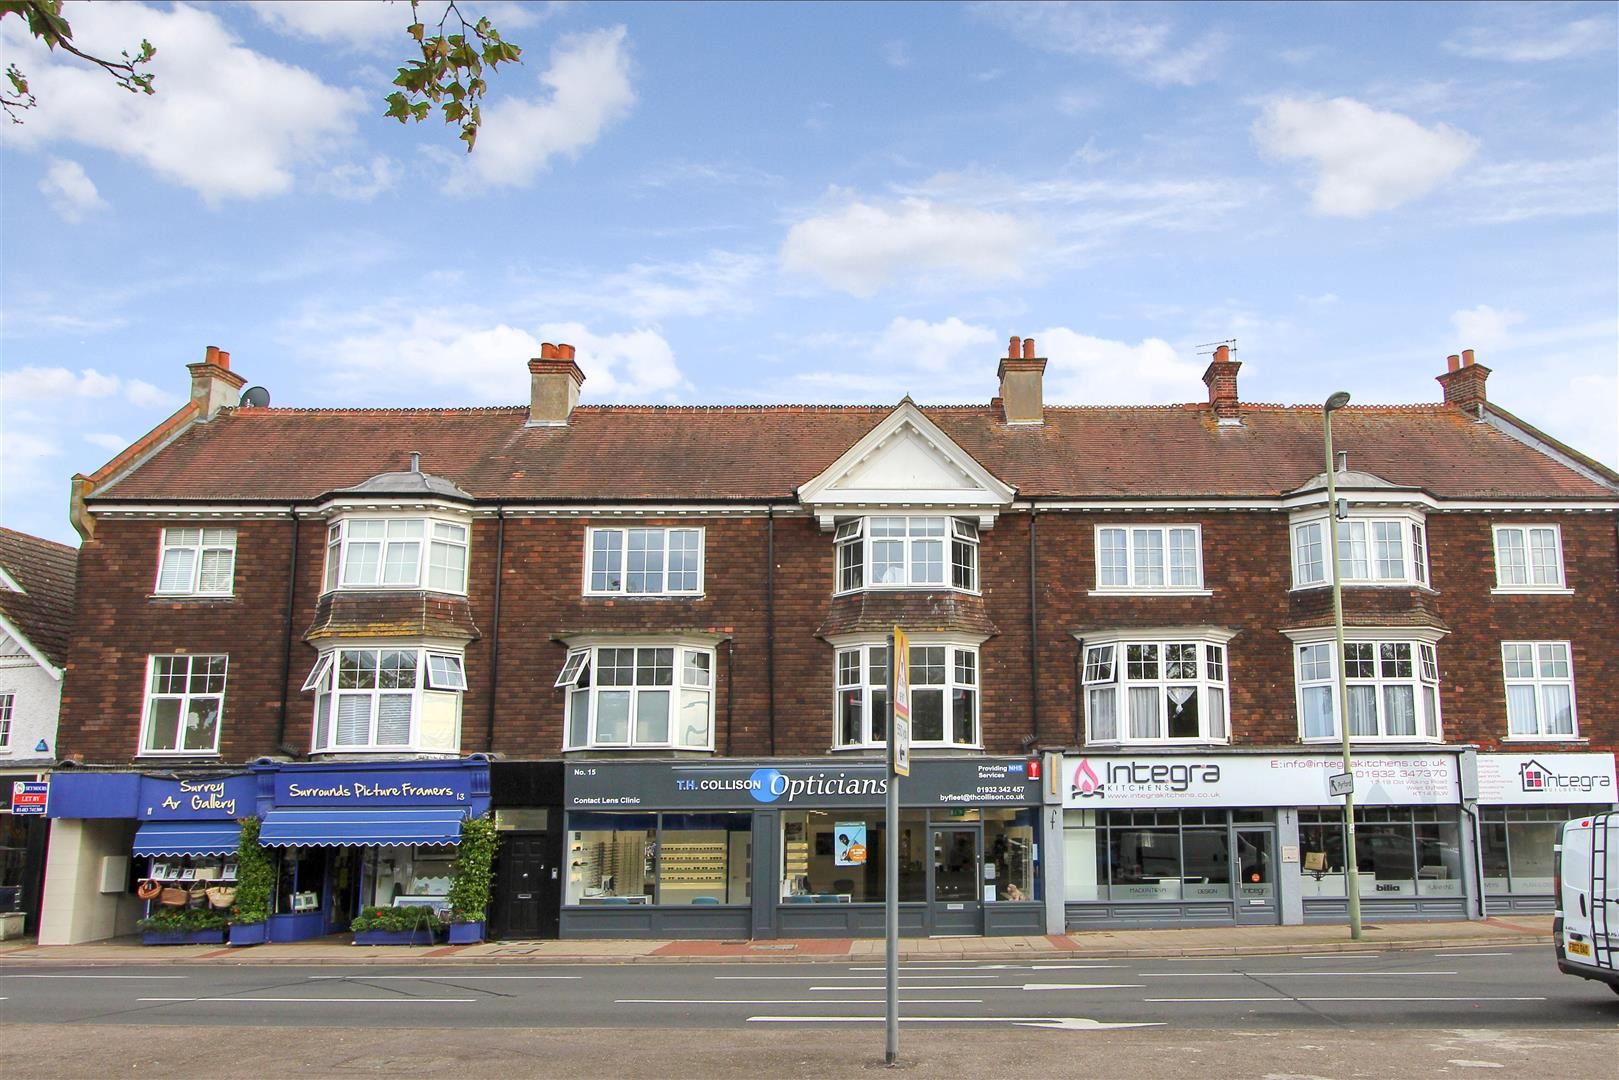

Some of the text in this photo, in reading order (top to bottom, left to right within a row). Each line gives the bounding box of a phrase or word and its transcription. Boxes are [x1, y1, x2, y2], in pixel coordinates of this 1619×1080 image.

[977, 765, 1008, 773] Providing
[1270, 759, 1447, 770] E:info@integakitchens.co.uk
[1107, 761, 1220, 791] Integra
[1356, 770, 1448, 778] 01932 347370
[180, 780, 224, 798] Surrey
[676, 773, 887, 802] T.H. COLLISON Opticians
[1107, 784, 1170, 792] KITCHENS
[1543, 773, 1610, 792] Integra
[289, 782, 454, 798] Surrounds Picture Framers
[191, 793, 236, 814] Gallery
[456, 793, 465, 801] 13
[940, 793, 1025, 802] byfleet@thcollison.co.uk
